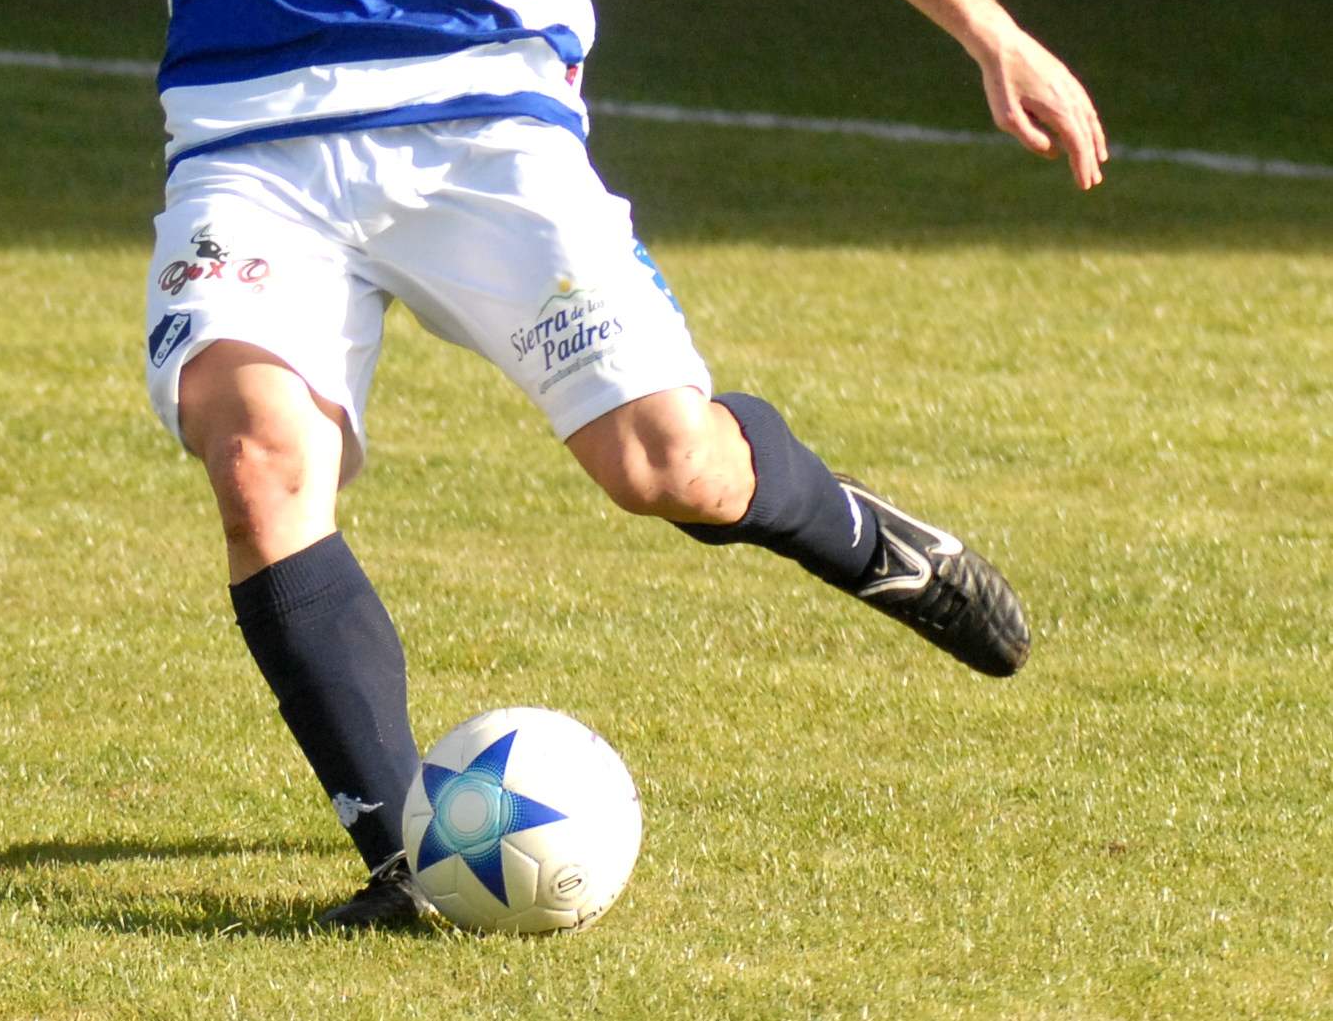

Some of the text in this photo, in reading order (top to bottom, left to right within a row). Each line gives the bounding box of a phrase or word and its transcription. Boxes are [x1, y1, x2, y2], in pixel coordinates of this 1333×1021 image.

[510, 309, 569, 362] Sierra
[570, 305, 584, 321] de
[542, 317, 623, 371] Padres
[557, 873, 582, 894] 5
